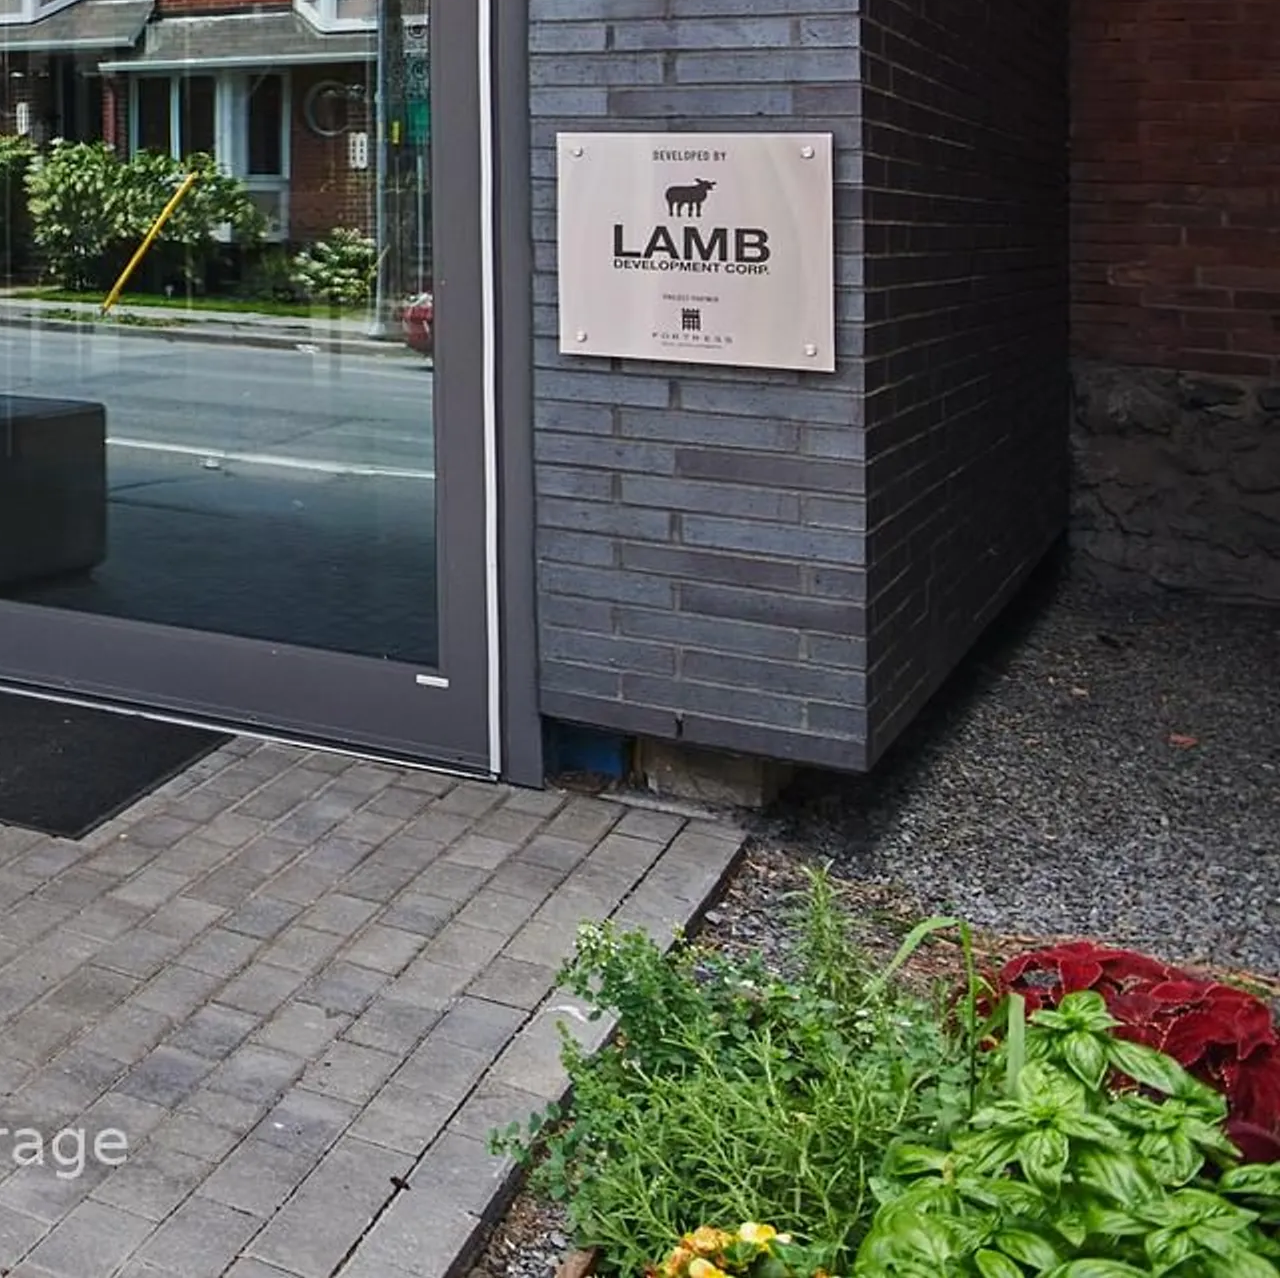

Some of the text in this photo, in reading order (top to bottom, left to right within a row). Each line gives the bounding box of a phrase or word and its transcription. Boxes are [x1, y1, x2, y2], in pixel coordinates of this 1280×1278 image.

[653, 150, 727, 162] DEVELOPED BY
[614, 224, 771, 263] LAMB
[614, 259, 770, 275] DEVELOPMENT CORP.
